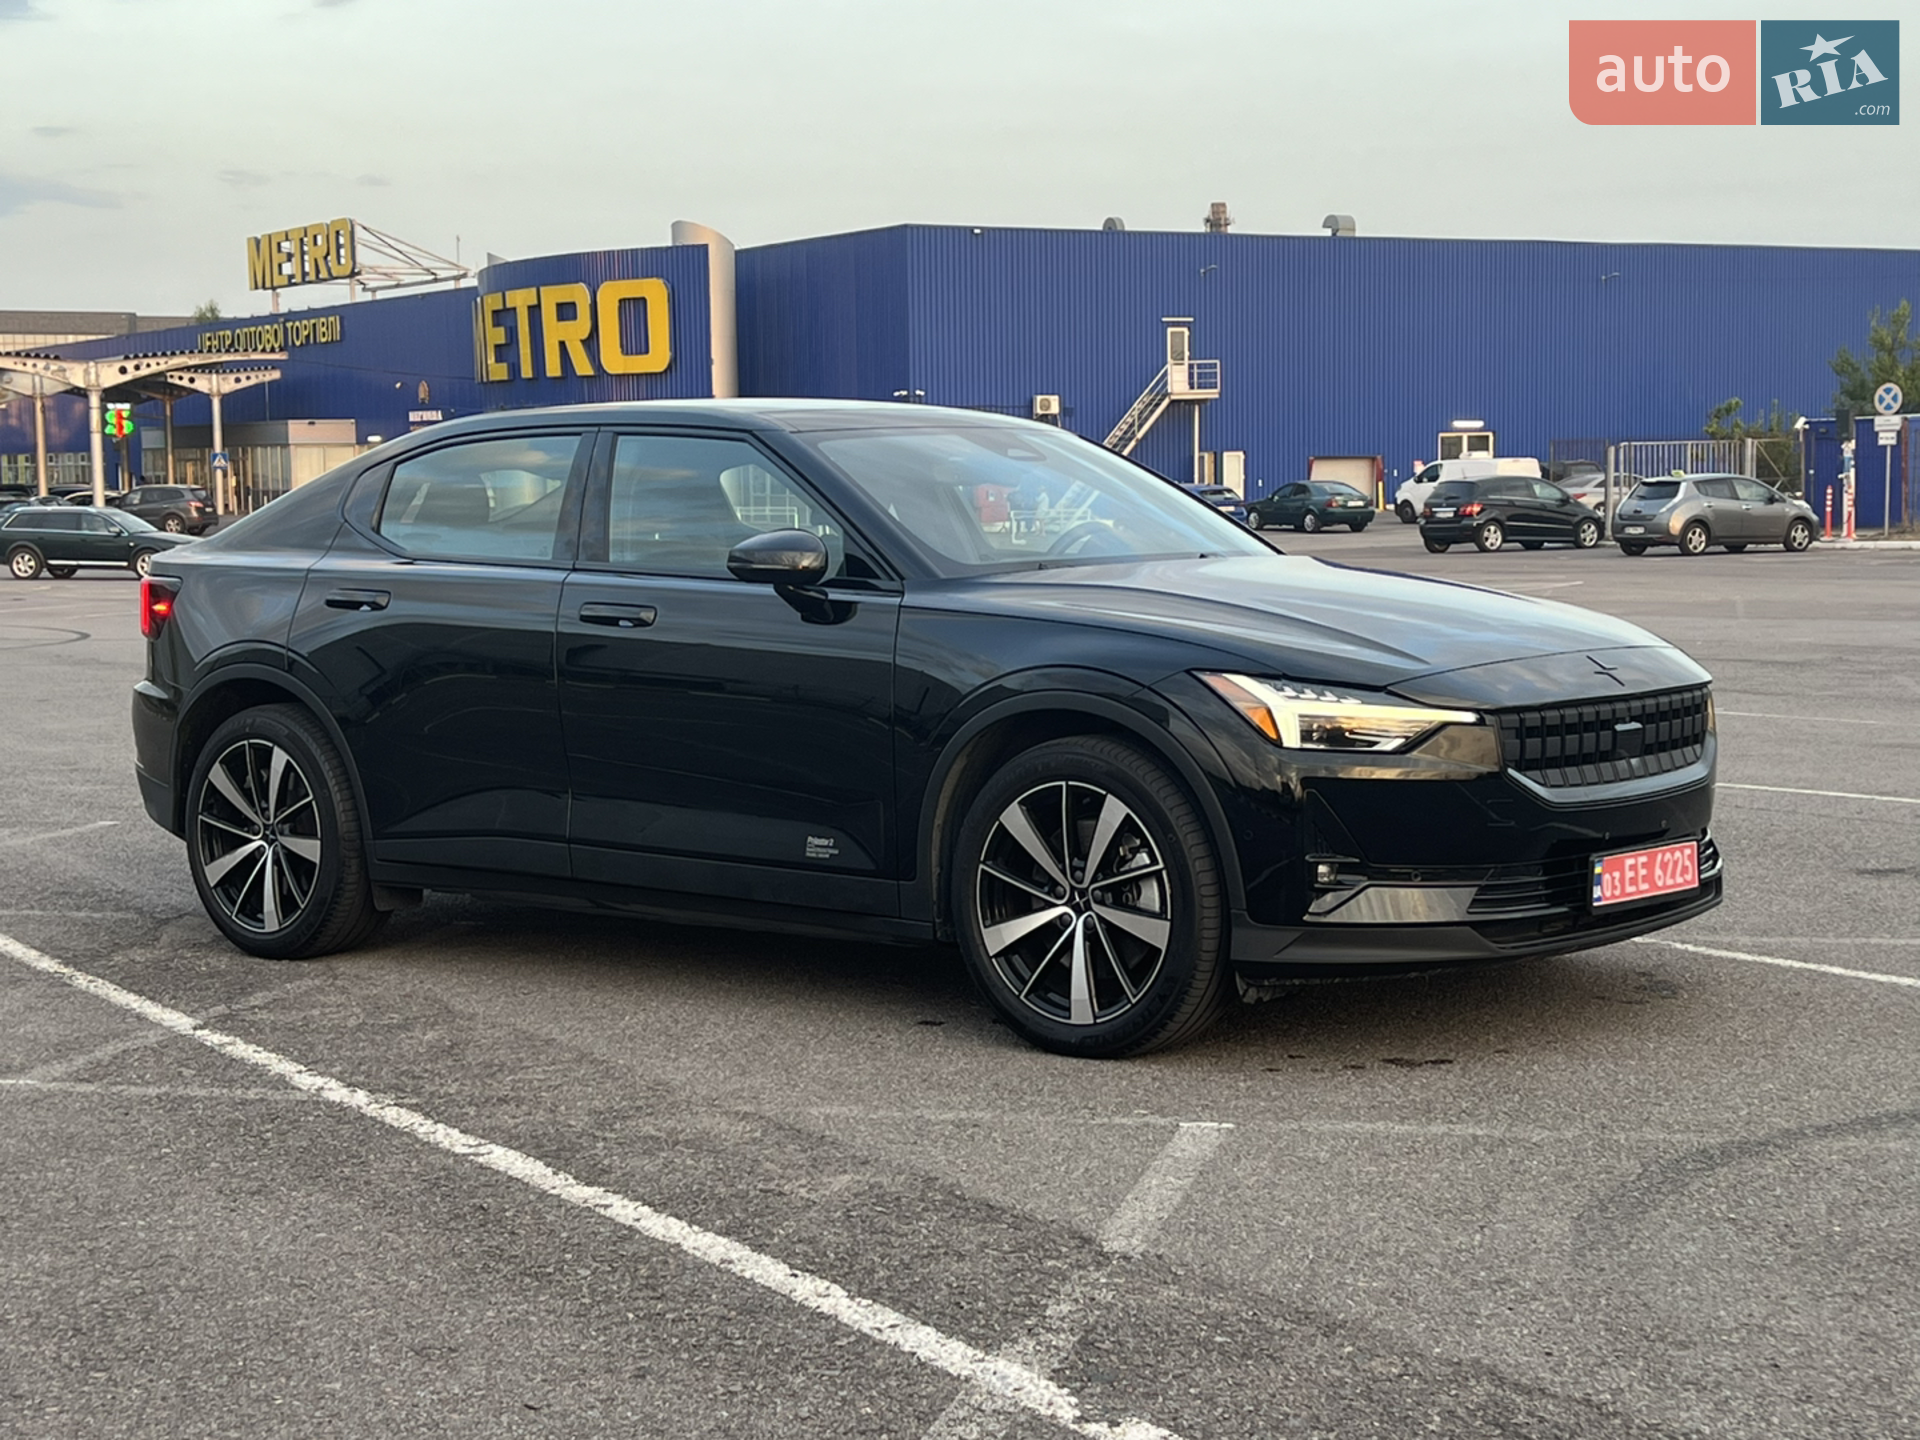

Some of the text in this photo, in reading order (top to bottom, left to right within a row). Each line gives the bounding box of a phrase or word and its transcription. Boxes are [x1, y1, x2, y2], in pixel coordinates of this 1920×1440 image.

[247, 217, 353, 291] METRO
[234, 318, 284, 350] ОПТОВОЇ
[285, 315, 341, 346] ТОРГІВЛІ
[1603, 848, 1693, 898] 03 EE 6225
